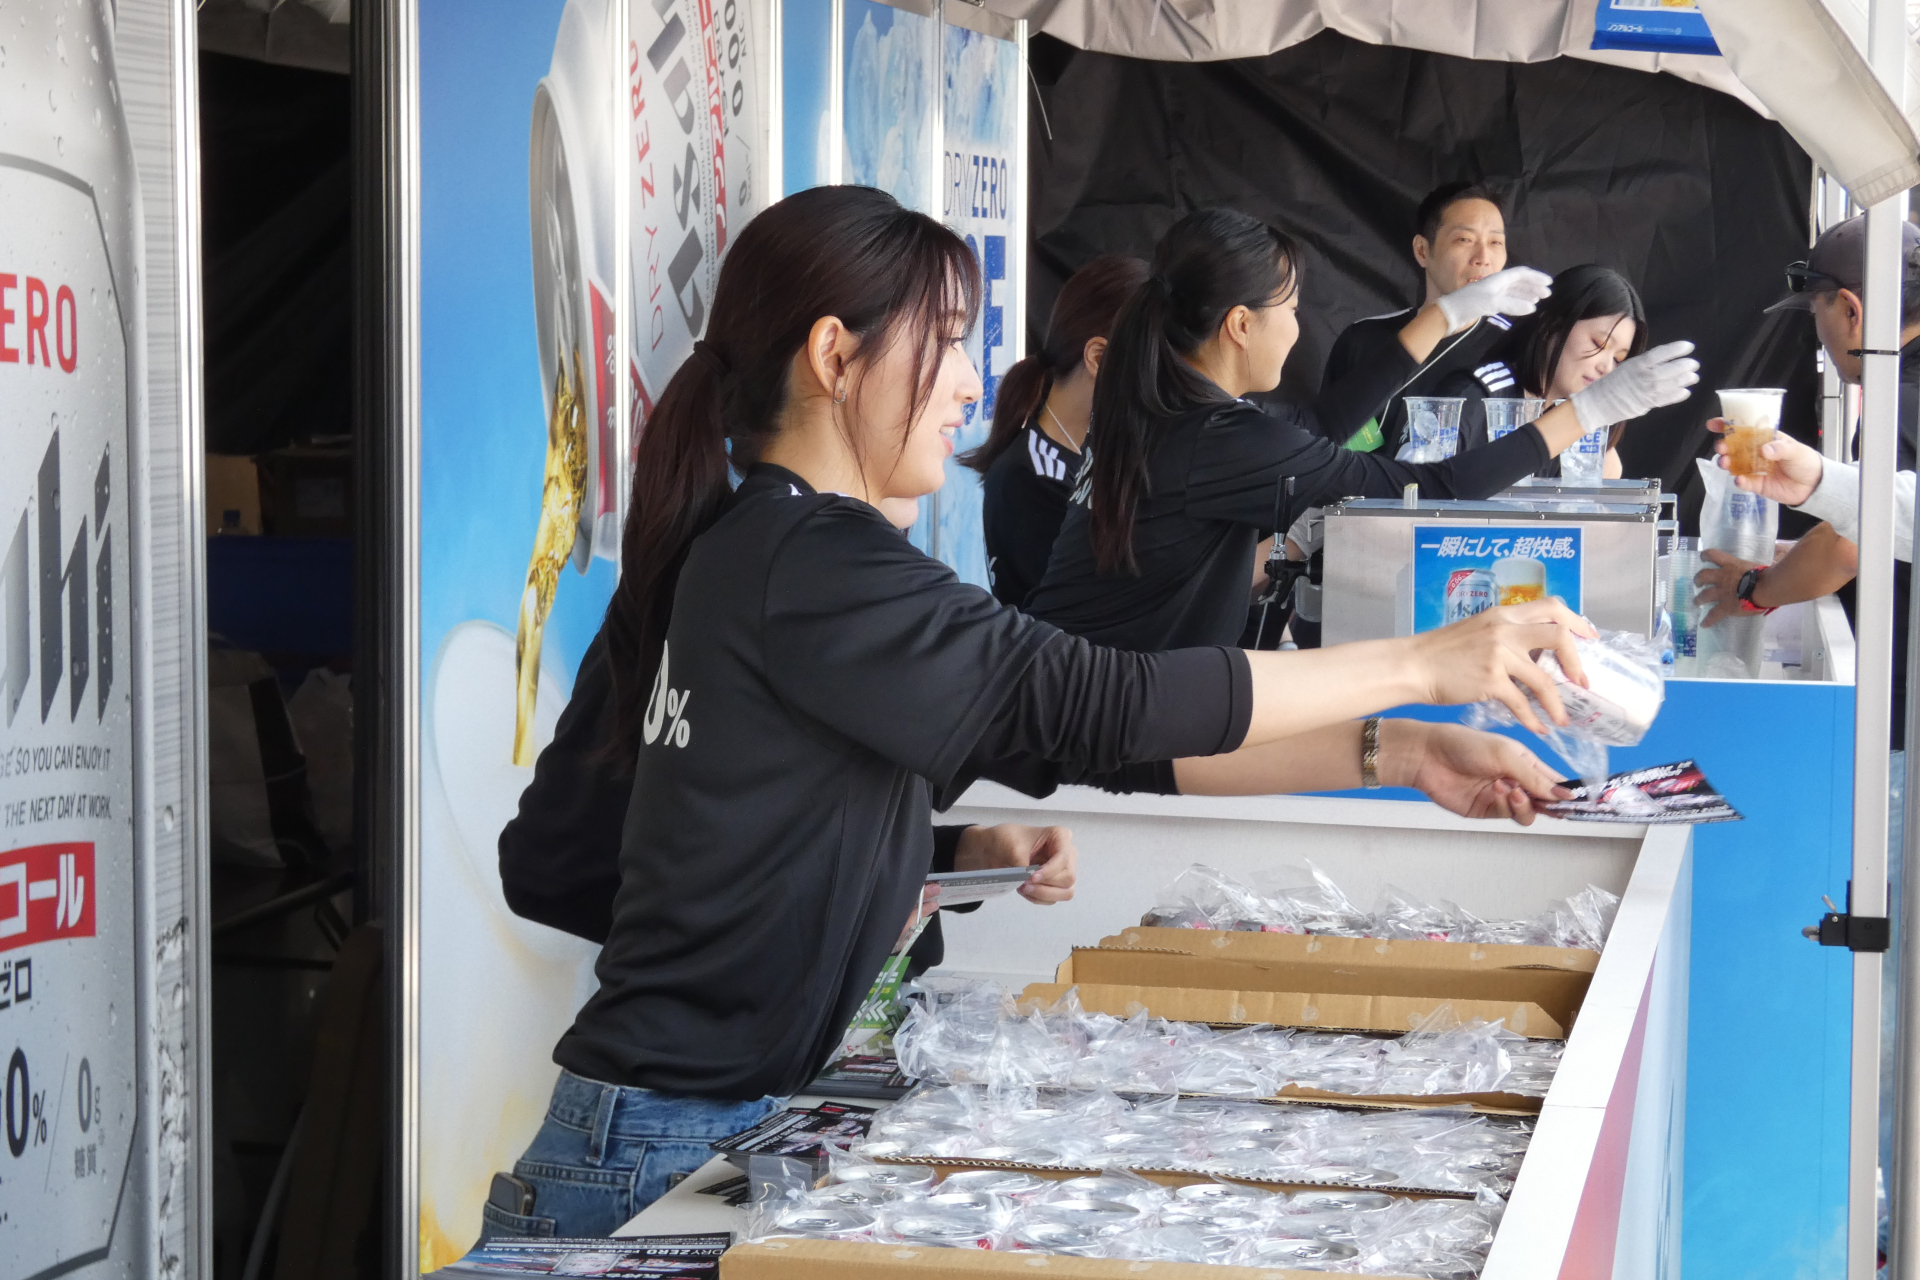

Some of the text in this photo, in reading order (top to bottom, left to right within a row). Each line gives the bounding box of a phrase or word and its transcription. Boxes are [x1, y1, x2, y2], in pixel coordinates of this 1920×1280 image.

[1420, 536, 1576, 559] 一瞬にして、超快感。
[1451, 600, 1493, 619] Asah
[15, 746, 30, 775] SO
[33, 746, 53, 772] YOU
[54, 744, 74, 770] CAN
[75, 744, 102, 771] ENJOY
[5, 800, 27, 828] THE
[29, 795, 56, 823] NEXT
[57, 792, 76, 819] DAY
[76, 793, 87, 819] AT
